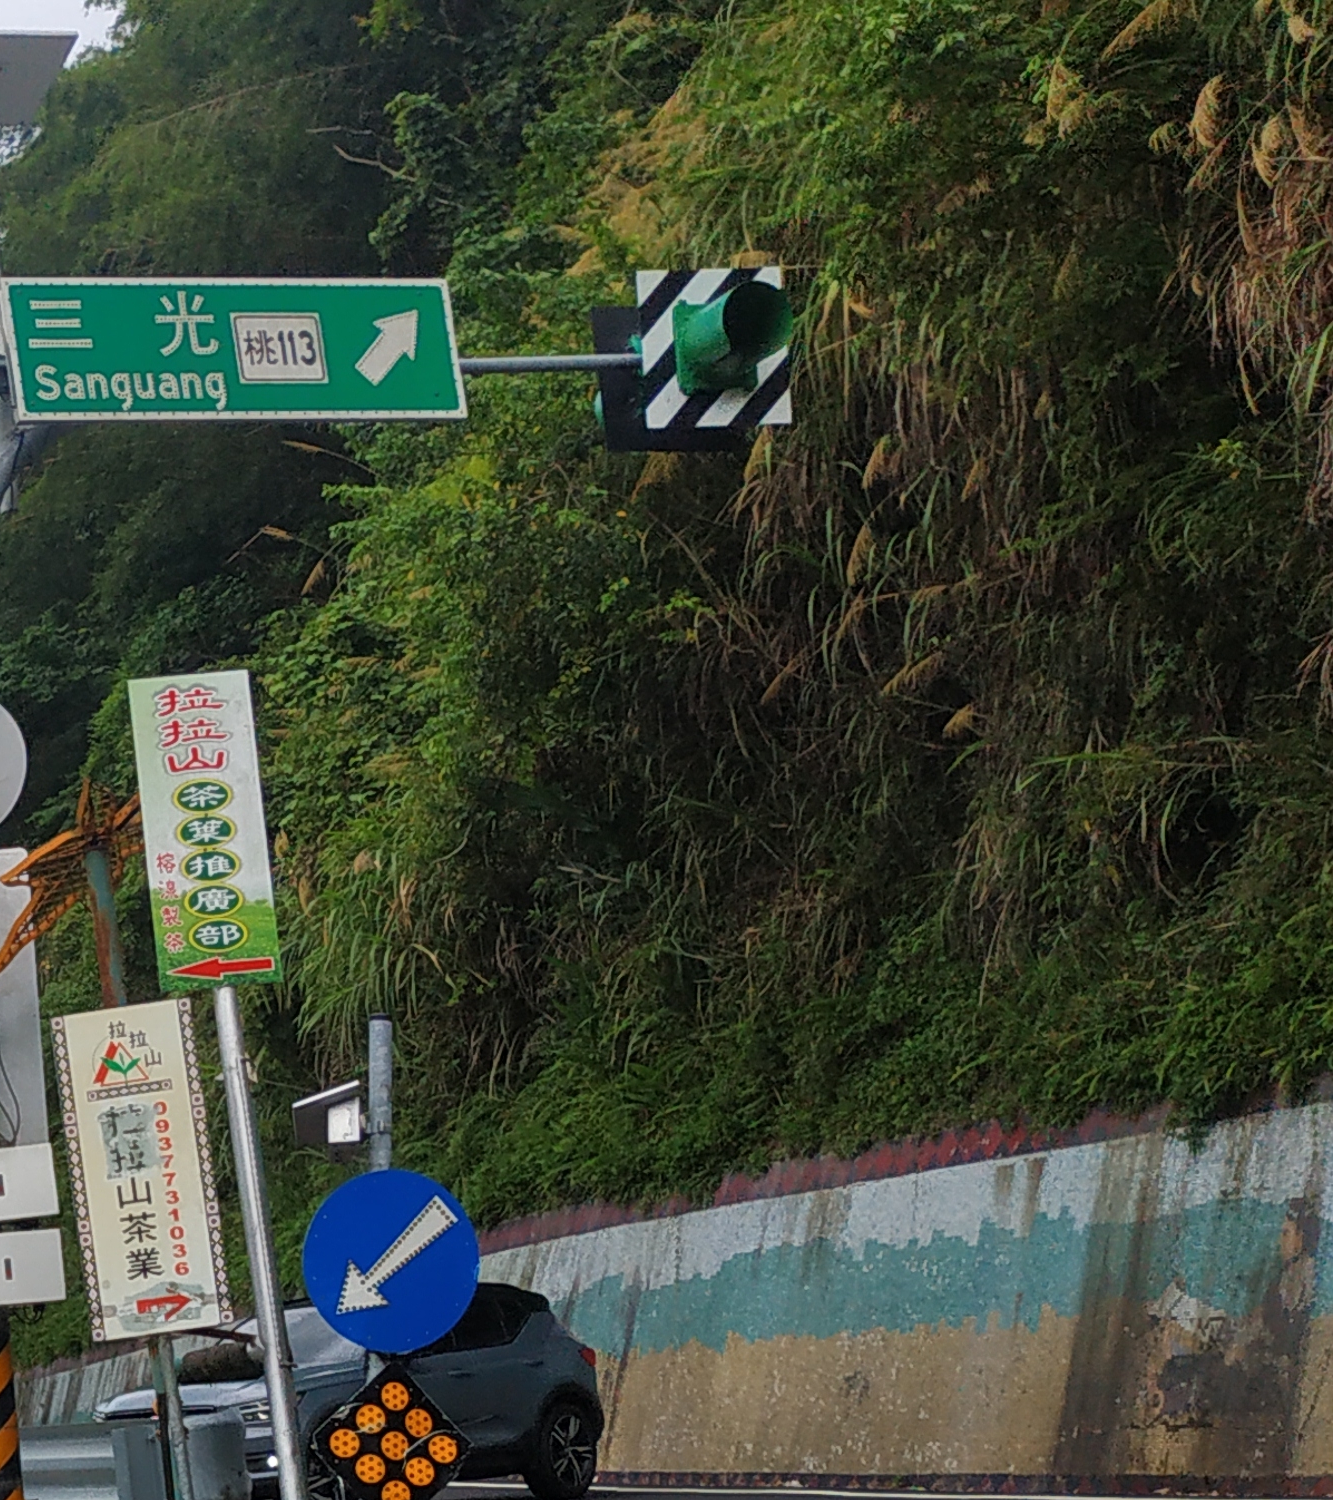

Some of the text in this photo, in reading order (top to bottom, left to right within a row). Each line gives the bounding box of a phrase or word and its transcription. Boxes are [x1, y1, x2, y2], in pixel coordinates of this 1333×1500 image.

[28, 290, 220, 358] 三光
[242, 329, 318, 367] 桃113
[34, 364, 228, 411] Sanguang
[156, 686, 229, 774] 拉拉山
[179, 784, 242, 948] 茶葉推廣部
[107, 1020, 163, 1068] 拉拉山
[153, 1101, 191, 1277] 0937731036
